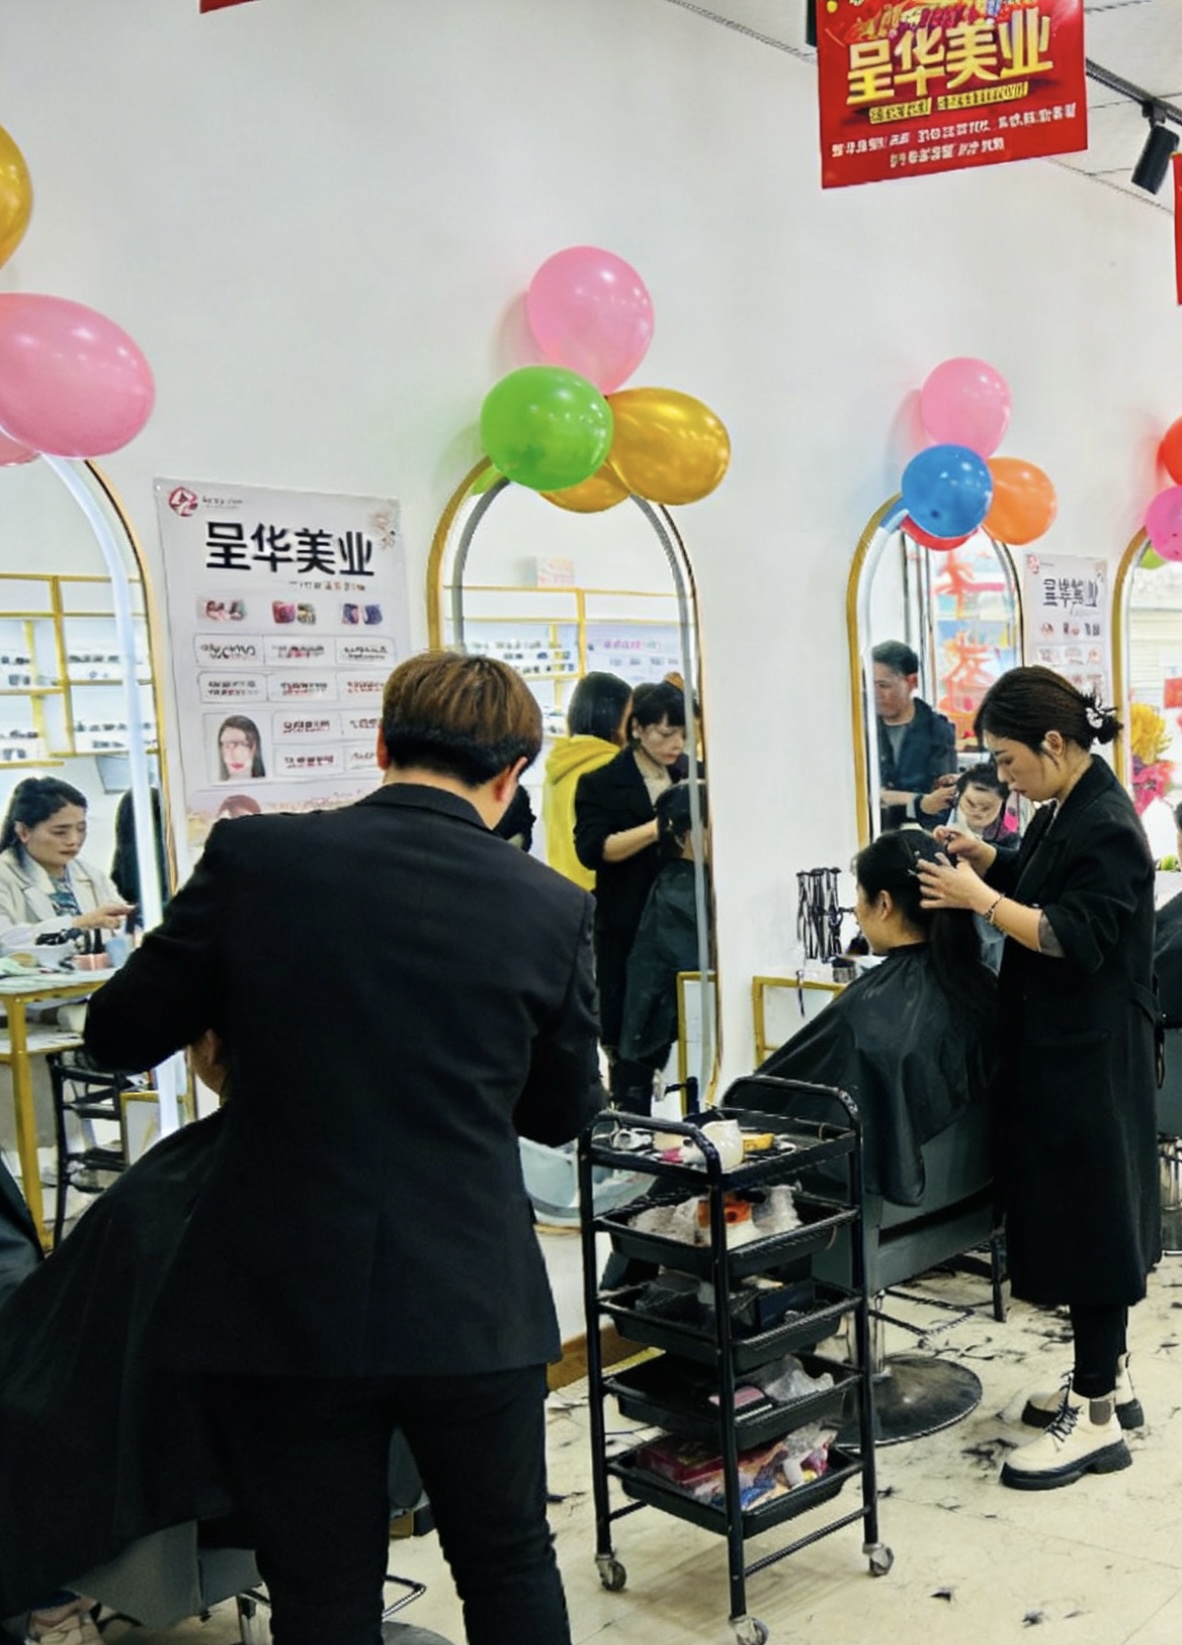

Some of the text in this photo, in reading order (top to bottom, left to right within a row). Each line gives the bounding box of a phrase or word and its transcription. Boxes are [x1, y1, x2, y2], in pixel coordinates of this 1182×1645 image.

[846, 8, 1054, 105] 呈华美业
[205, 520, 375, 577] 呈华美业
